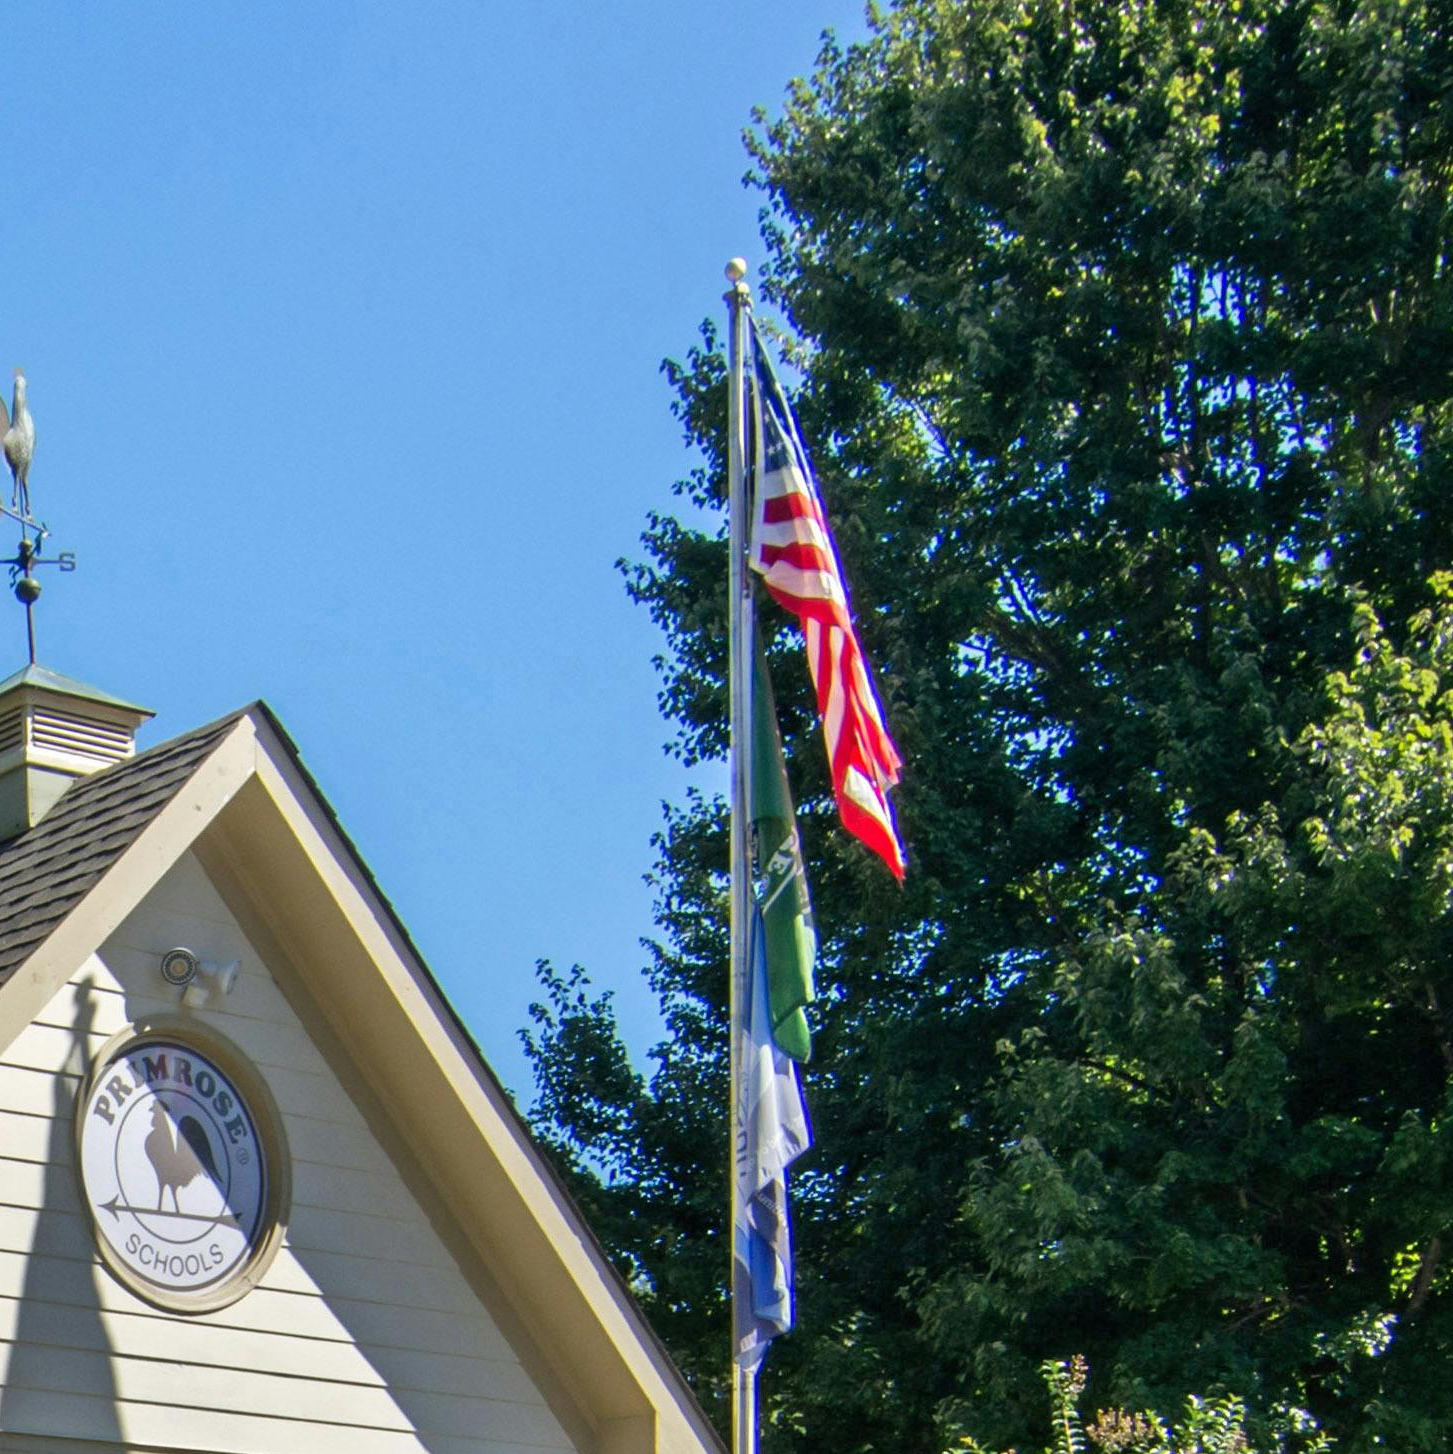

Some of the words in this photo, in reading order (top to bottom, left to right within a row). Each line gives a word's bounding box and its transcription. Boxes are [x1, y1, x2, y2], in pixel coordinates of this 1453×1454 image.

[59, 553, 75, 571] S
[94, 1054, 248, 1144] PRIMROSE
[125, 1233, 224, 1277] SCHOOLS
